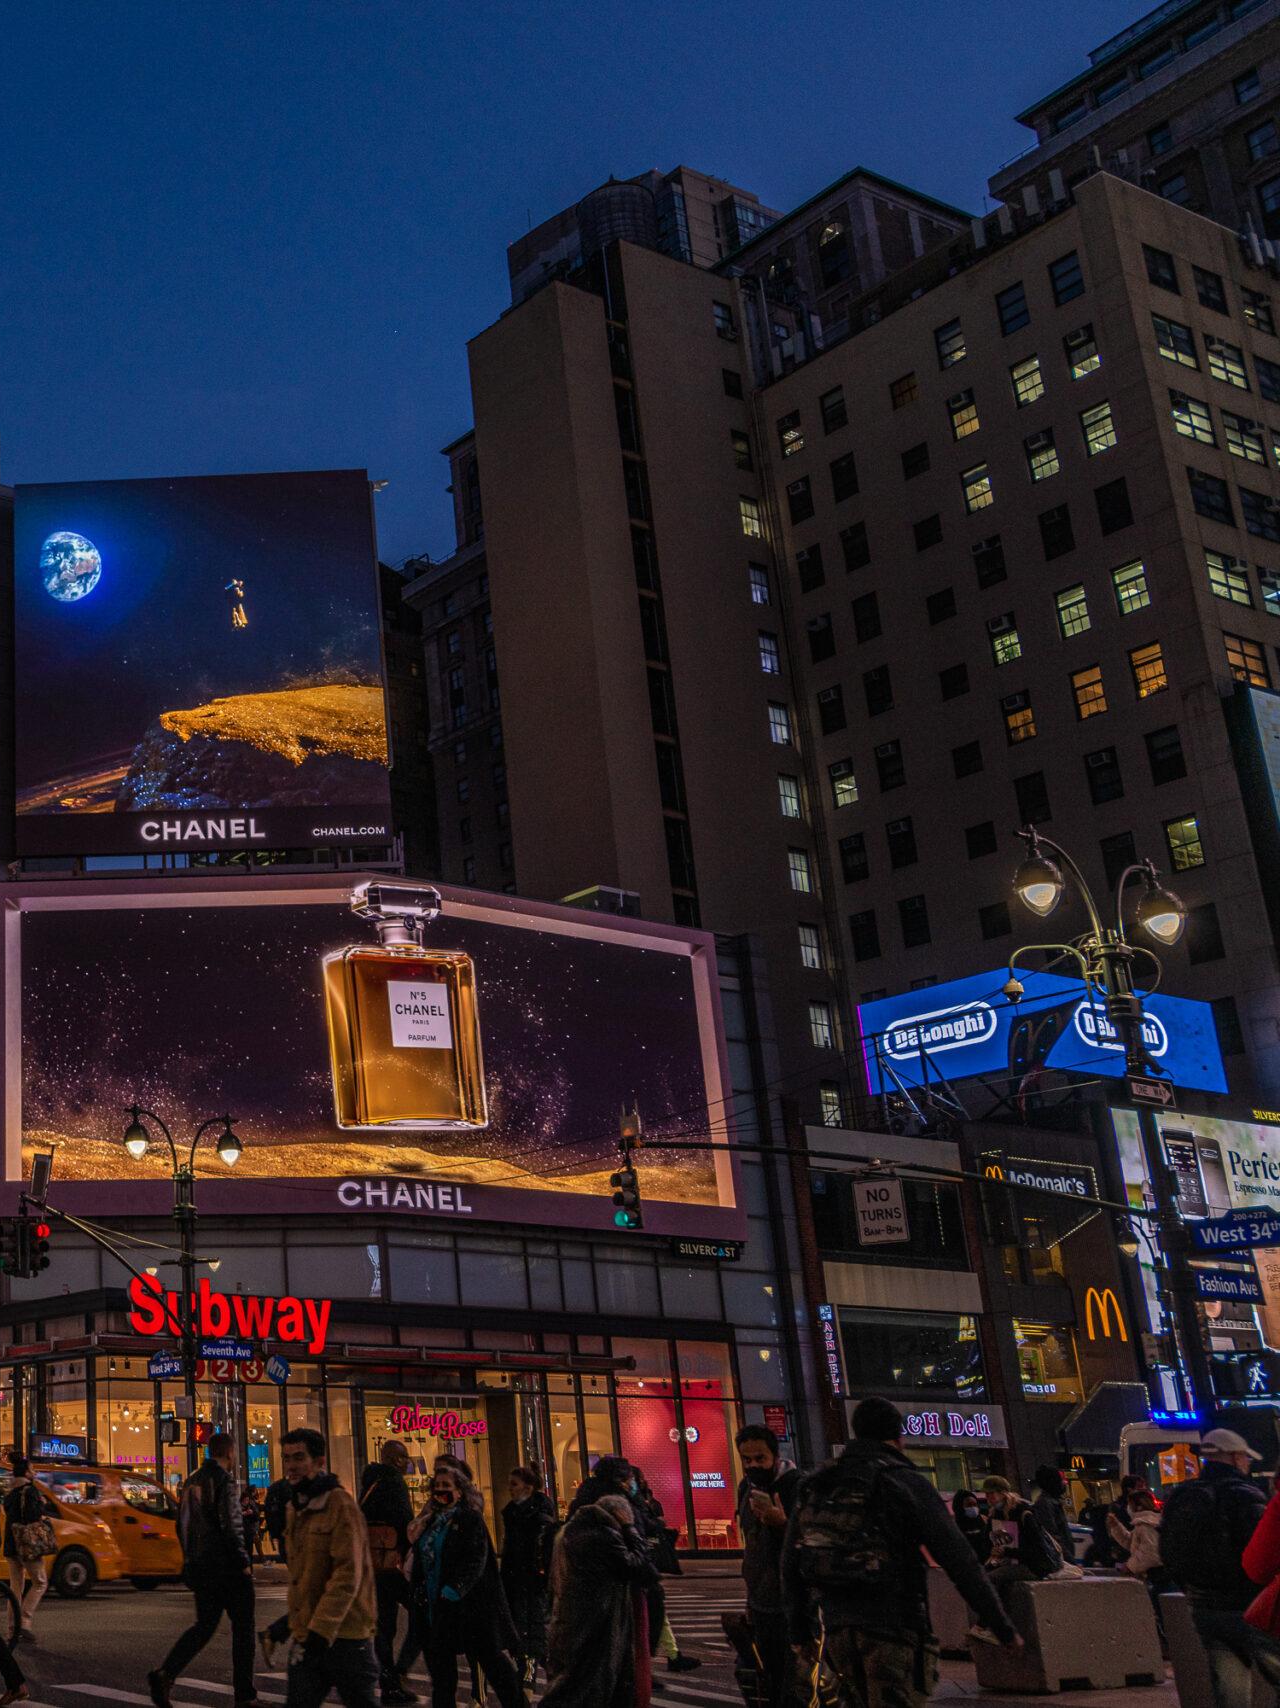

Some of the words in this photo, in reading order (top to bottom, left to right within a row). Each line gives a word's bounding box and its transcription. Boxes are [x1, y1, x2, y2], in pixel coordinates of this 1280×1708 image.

[140, 818, 266, 842] CHANEL
[312, 825, 386, 838] CHANEL.COM
[395, 1004, 445, 1017] CHANEL
[408, 1034, 437, 1042] PARFUM
[1135, 1083, 1149, 1096] ONE
[1153, 1088, 1167, 1099] WAY
[1008, 1170, 1086, 1195] McDonald's
[1234, 1181, 1267, 1196] Espresso
[337, 1180, 473, 1214] CHANEL
[866, 1188, 890, 1202] NO
[860, 1208, 902, 1222] TURNS
[863, 1224, 903, 1237] 8AM-8PM
[1199, 1226, 1245, 1245] West
[1251, 1221, 1280, 1240] 34th
[679, 1243, 736, 1258] SILVERCAST
[1199, 1275, 1237, 1294] Fashion
[1239, 1279, 1259, 1296] Ave
[128, 1273, 332, 1355] Subway
[202, 1344, 234, 1356] Seventh
[236, 1346, 252, 1358] Ave
[150, 1364, 163, 1375] West
[163, 1363, 174, 1374] 34th
[174, 1362, 181, 1372] St
[216, 1359, 229, 1378] 2
[245, 1359, 259, 1378] 3
[267, 1358, 286, 1380] MTA
[827, 1353, 840, 1393] DELI
[391, 1403, 443, 1436] Riley
[442, 1411, 487, 1439] Rose
[947, 1412, 991, 1437] Deli
[692, 1472, 708, 1480] WISH
[708, 1472, 722, 1480] YOU
[690, 1480, 708, 1488] WERE
[708, 1480, 725, 1488] HERE
